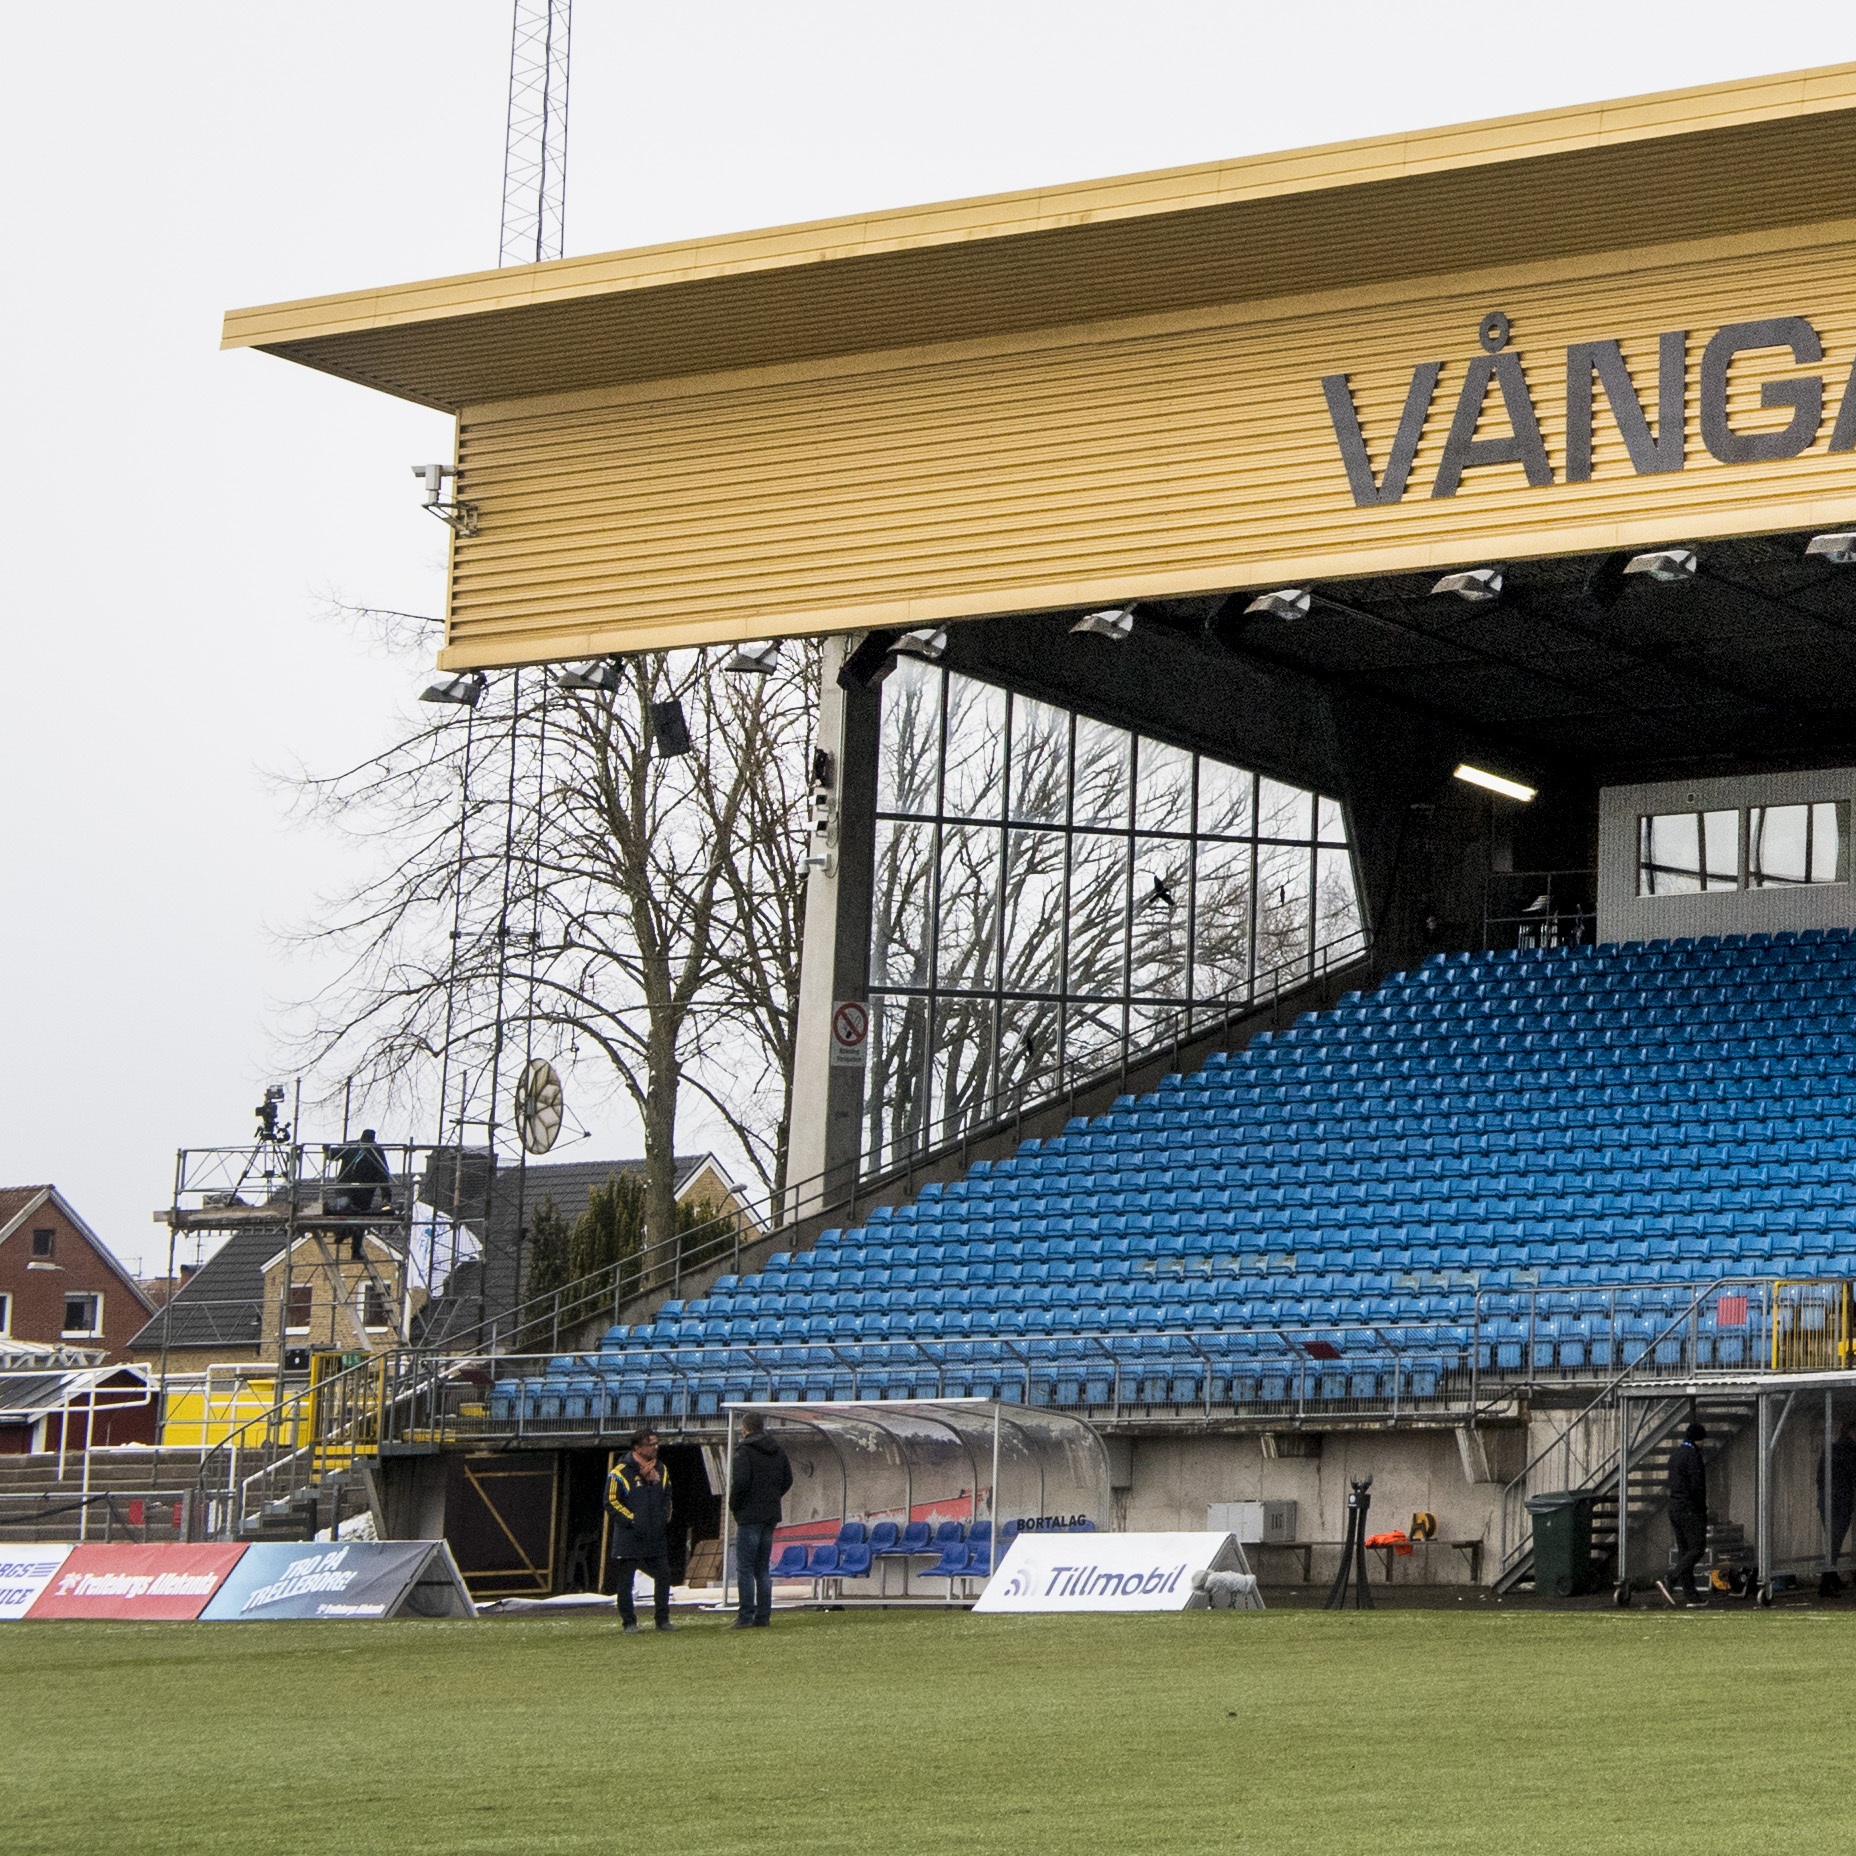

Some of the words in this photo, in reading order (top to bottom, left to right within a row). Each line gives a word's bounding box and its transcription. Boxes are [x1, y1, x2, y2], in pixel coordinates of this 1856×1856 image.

[1017, 1514, 1087, 1532] BORTALAG
[0, 1563, 36, 1578] RGS
[279, 1554, 322, 1581] TRO
[315, 1545, 350, 1573] PÅ
[73, 1573, 153, 1599] Trelleborgs
[146, 1572, 218, 1595] Allehanda
[240, 1571, 358, 1613] TRELLEBORG!
[1044, 1564, 1187, 1596] Tillmobil
